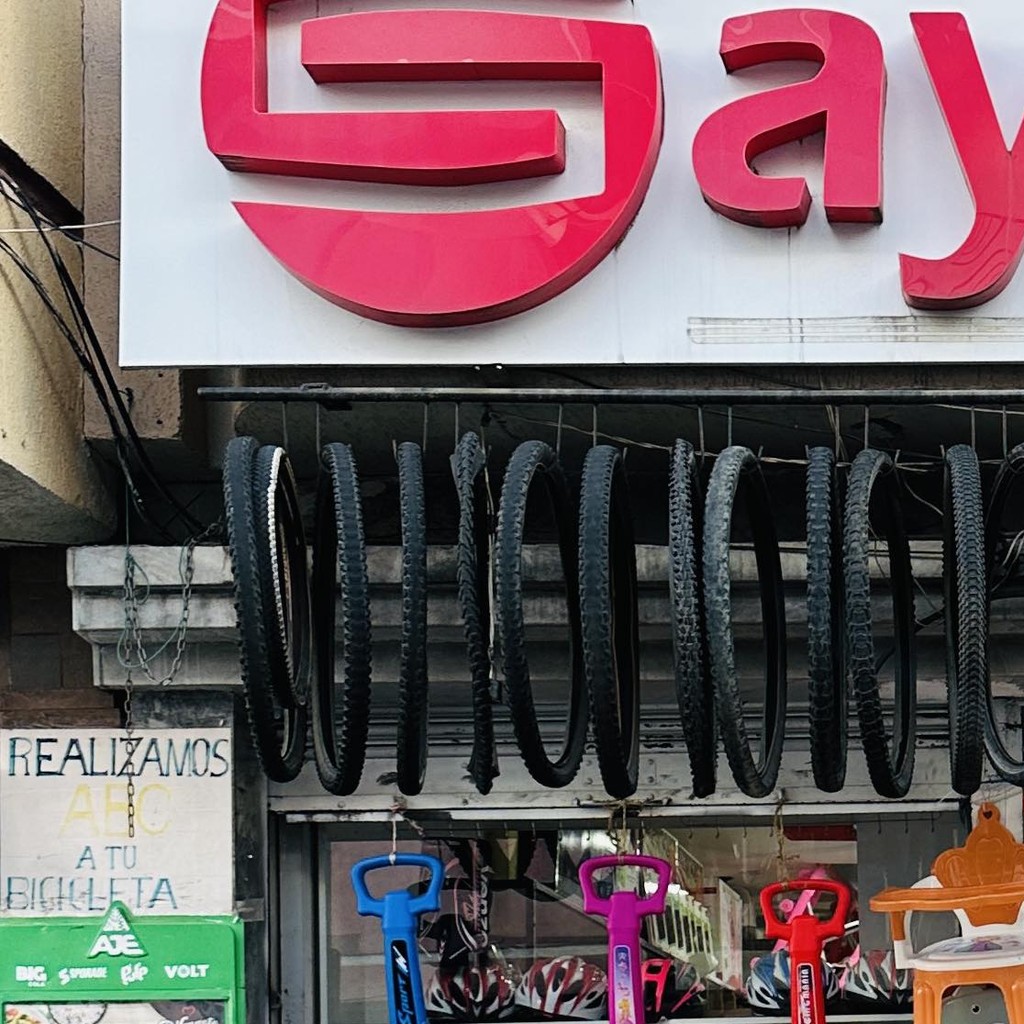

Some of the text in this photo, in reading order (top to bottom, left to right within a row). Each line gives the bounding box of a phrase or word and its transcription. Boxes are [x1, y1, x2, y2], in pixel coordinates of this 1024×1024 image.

[8, 737, 230, 777] REALIZAMOS
[75, 845, 137, 870] A TU
[88, 934, 146, 957] AJE
[16, 966, 47, 981] BIG
[164, 964, 209, 978] VOLT
